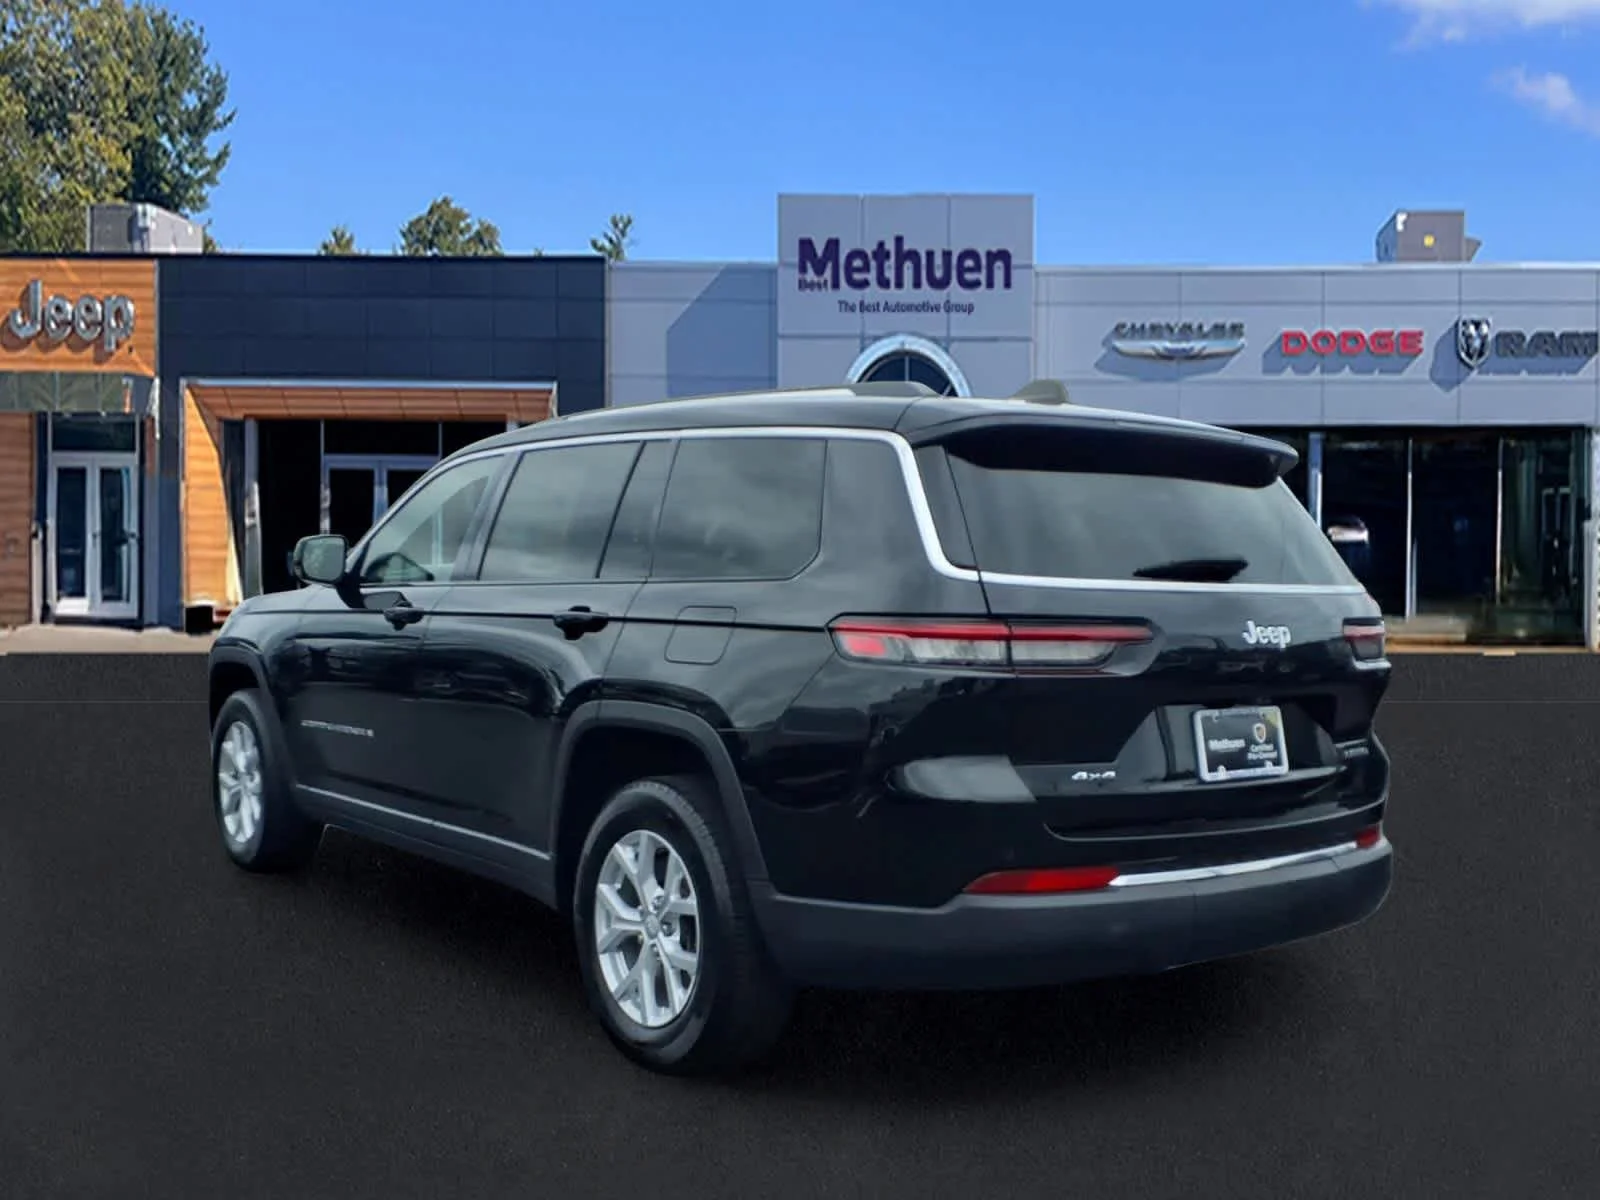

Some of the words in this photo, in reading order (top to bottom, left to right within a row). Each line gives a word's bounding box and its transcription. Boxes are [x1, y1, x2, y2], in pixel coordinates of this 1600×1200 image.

[798, 235, 1012, 290] Methuen
[9, 280, 135, 352] Jeep
[838, 300, 857, 313] The
[859, 300, 880, 313] Best
[882, 300, 941, 313] Automotive
[943, 300, 975, 316] Group
[1114, 322, 1245, 339] CHRYSLER
[1281, 330, 1424, 356] DODGE
[1495, 331, 1599, 358] RAM
[1242, 620, 1292, 649] Jeep
